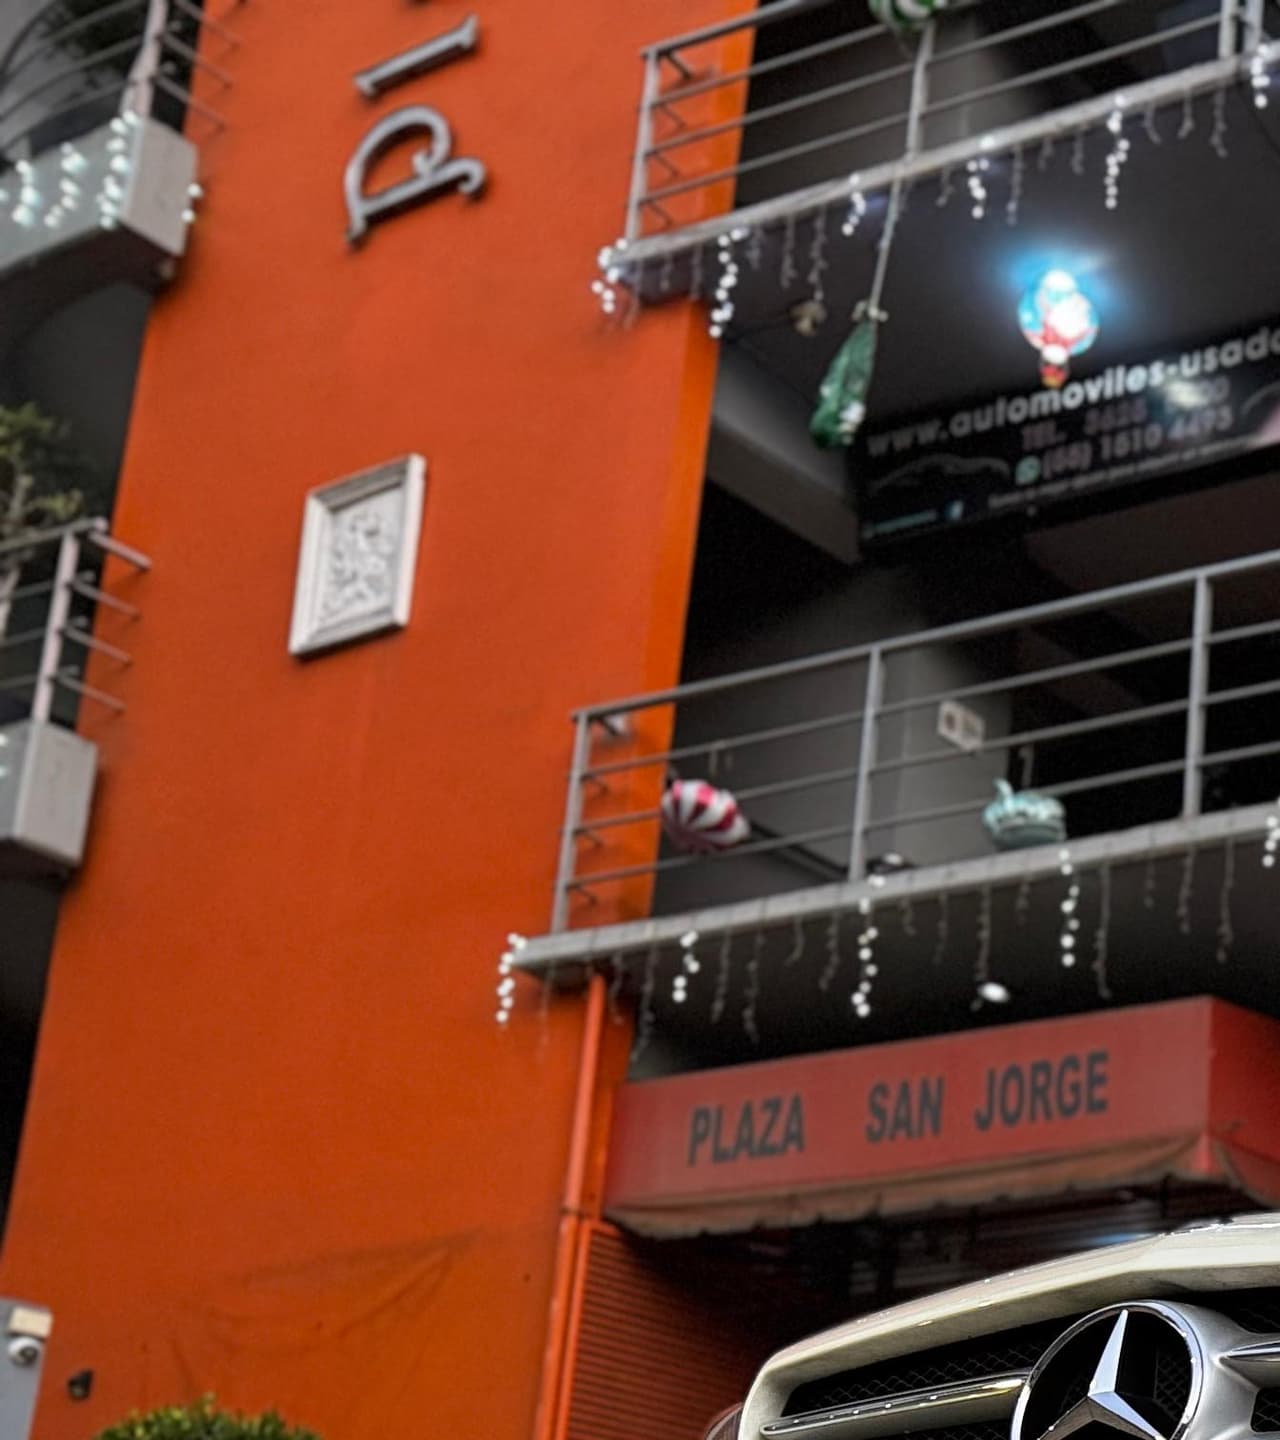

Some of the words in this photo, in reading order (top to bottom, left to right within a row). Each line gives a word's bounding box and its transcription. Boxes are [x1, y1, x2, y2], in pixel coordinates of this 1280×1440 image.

[687, 1092, 805, 1166] PLAZA
[865, 1075, 945, 1143] SAN
[974, 1051, 1110, 1132] JORGE
